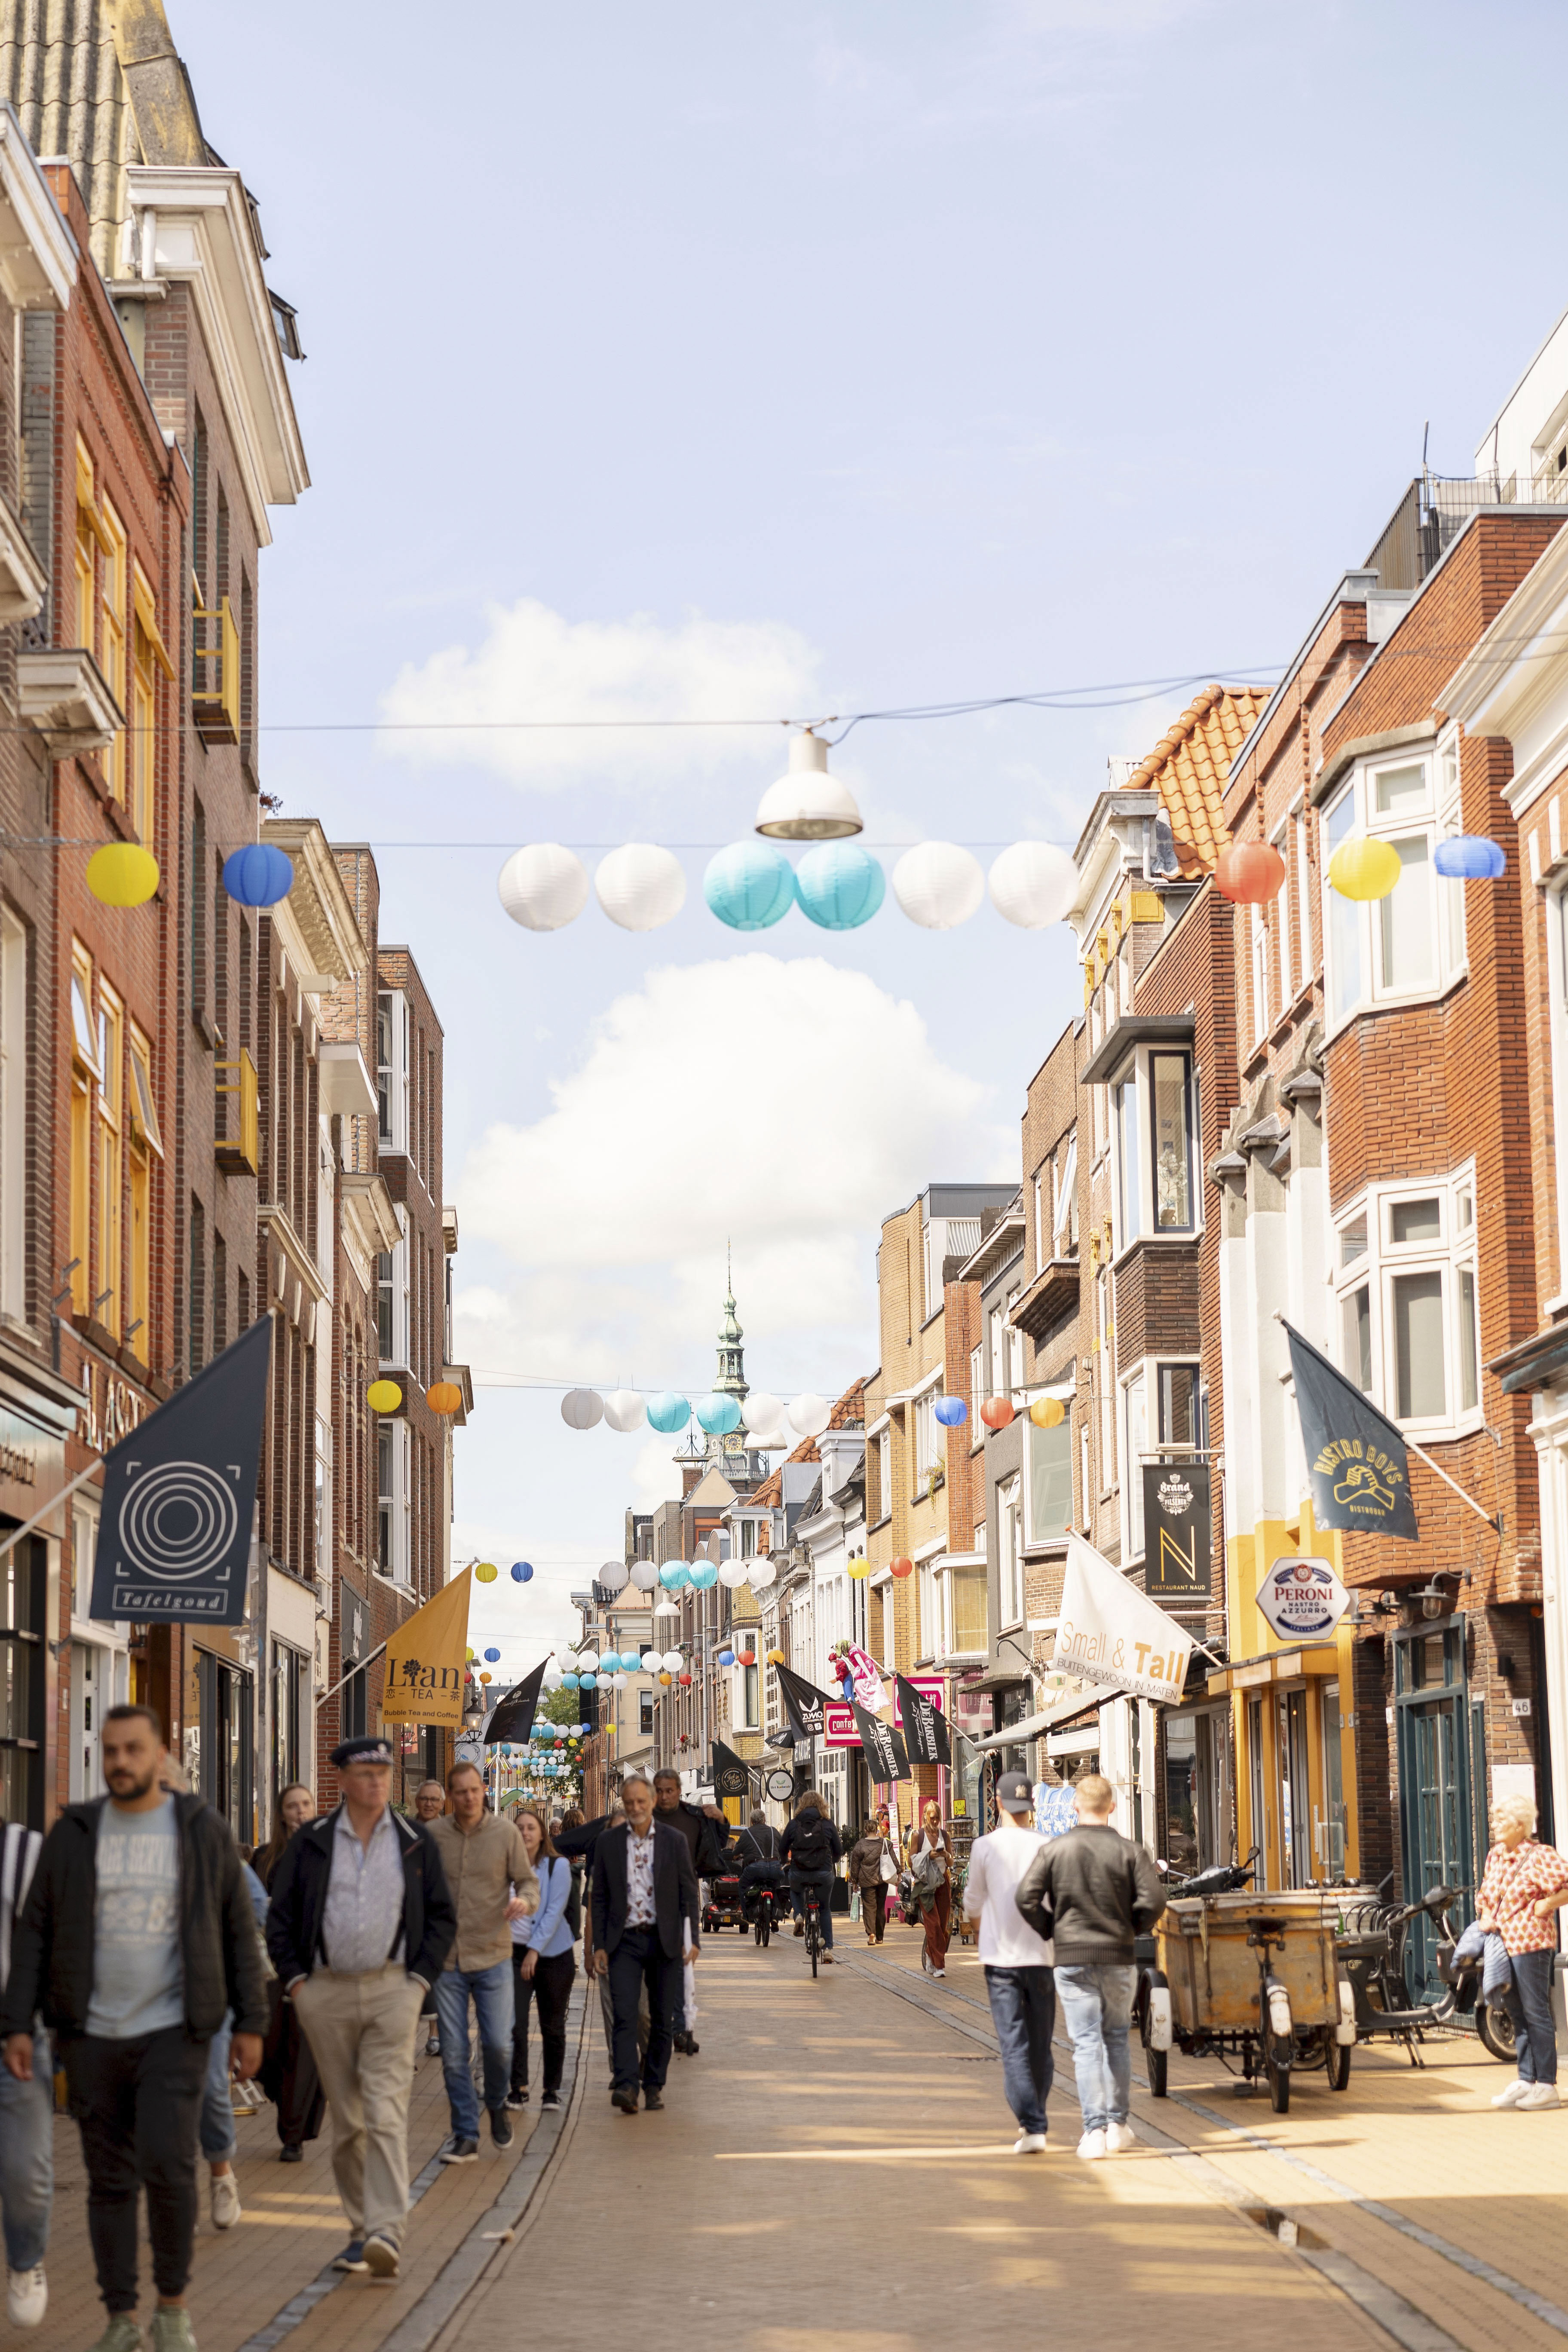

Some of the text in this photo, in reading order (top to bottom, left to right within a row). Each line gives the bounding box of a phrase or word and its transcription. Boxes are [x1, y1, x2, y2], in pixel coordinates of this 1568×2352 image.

[1314, 1439, 1403, 1485] BISTRO BOYS
[1161, 1481, 1190, 1493] Brand
[1164, 1498, 1187, 1506] PILSENER
[1350, 1505, 1385, 1516] BISTROBAR
[1160, 1525, 1195, 1581] N
[122, 1592, 220, 1609] Tafelgoud
[1274, 1587, 1332, 1601] PERONI
[1061, 1622, 1184, 1684] Small & Tall
[387, 1658, 461, 1690] Lian
[1057, 1658, 1178, 1700] BUITENGEWOON IN MATEN
[411, 1688, 434, 1700] TEA
[450, 1690, 460, 1701] 茶
[1515, 1702, 1528, 1712] 46
[802, 1711, 823, 1720] ZUMO
[833, 1718, 852, 1731] confe
